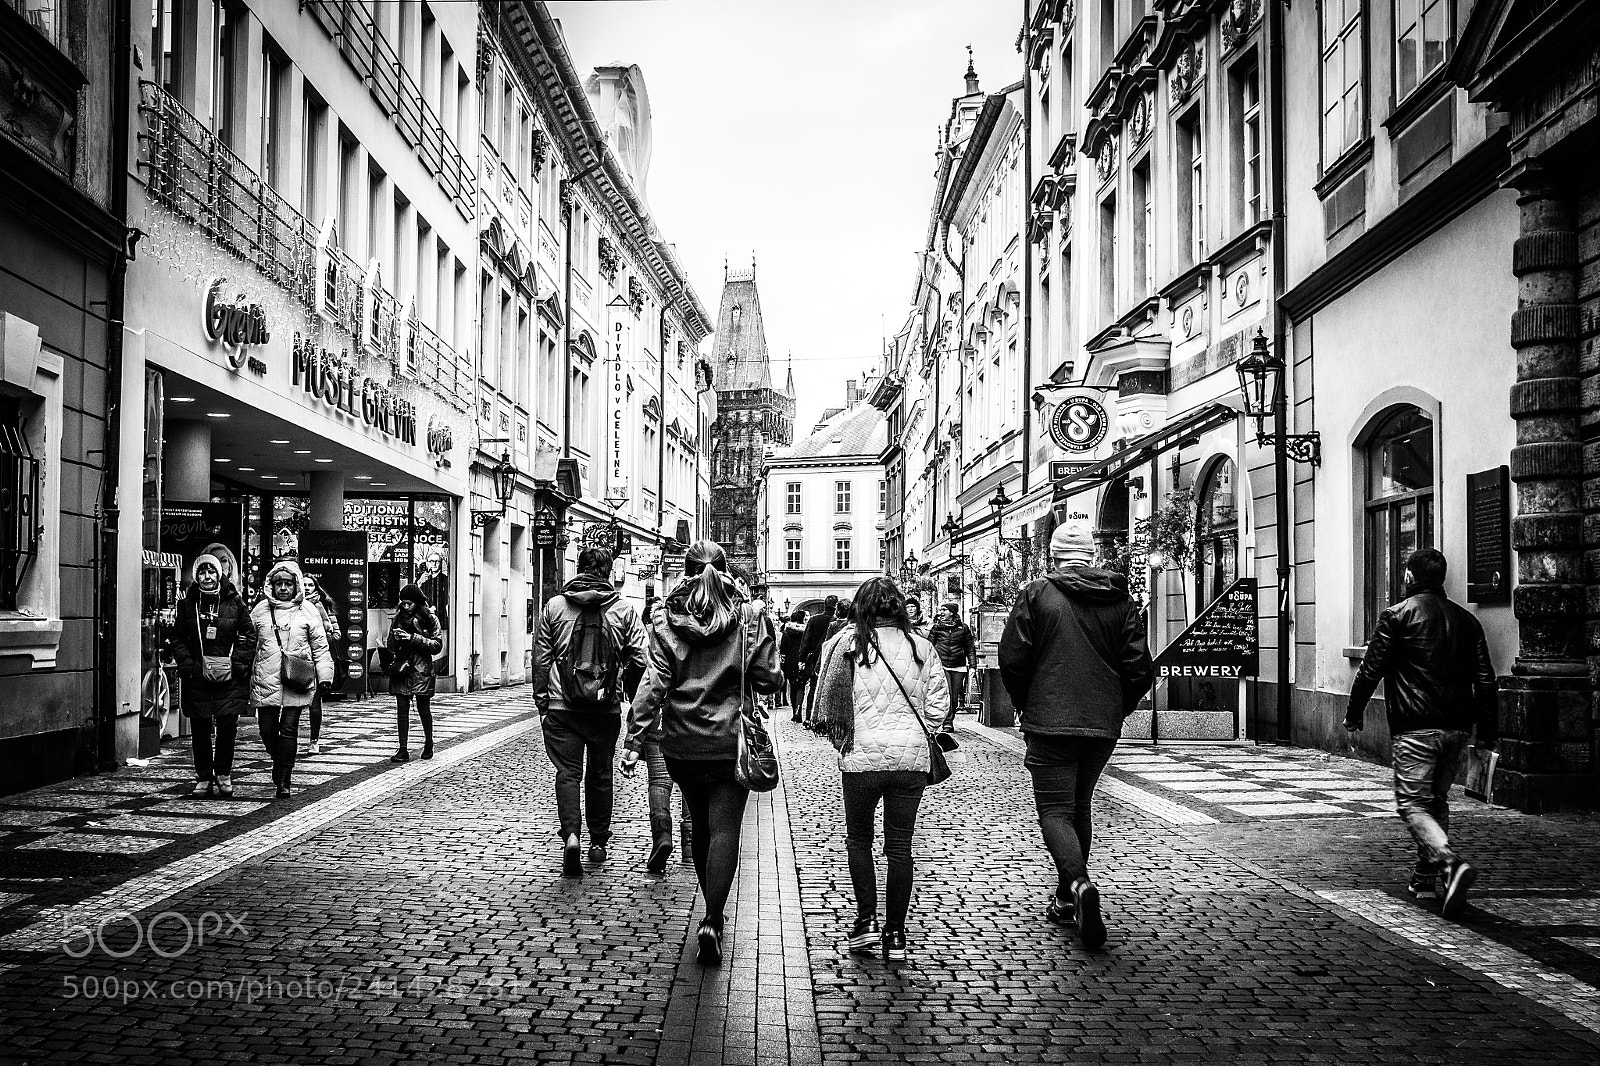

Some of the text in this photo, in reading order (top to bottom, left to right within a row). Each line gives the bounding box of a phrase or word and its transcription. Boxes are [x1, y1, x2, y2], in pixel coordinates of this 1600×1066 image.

[614, 322, 623, 392] DIVADLO
[304, 556, 329, 565] CENÍK
[335, 558, 364, 566] PRICES
[1160, 665, 1242, 677] BREWERY
